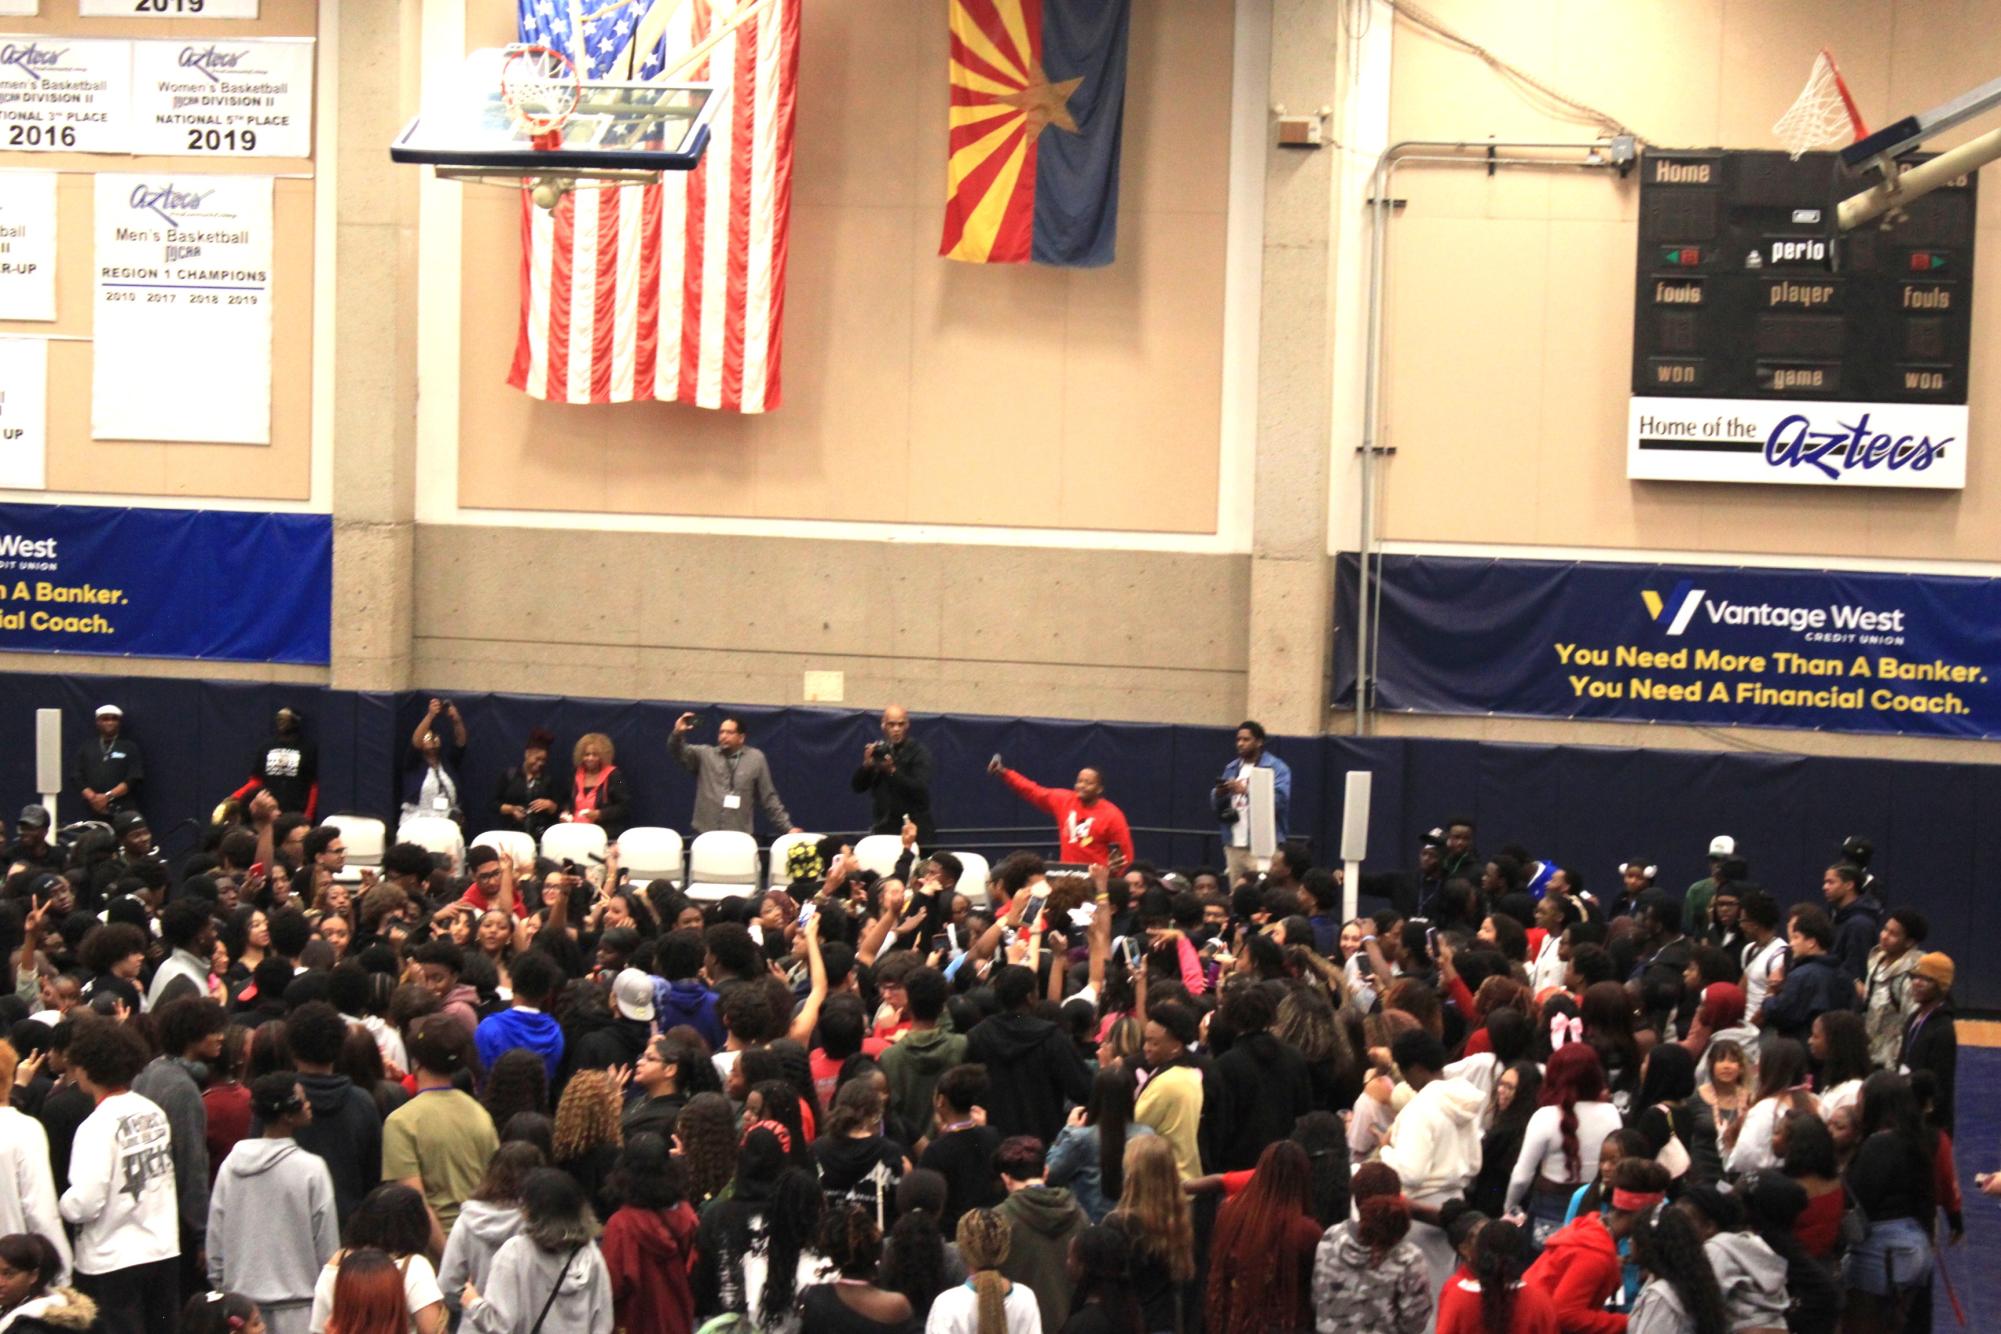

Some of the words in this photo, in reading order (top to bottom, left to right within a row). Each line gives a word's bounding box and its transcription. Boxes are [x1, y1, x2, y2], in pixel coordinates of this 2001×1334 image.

[135, 0, 205, 12] 2019
[42, 79, 107, 91] Basketball
[220, 82, 289, 94] Basketball
[22, 92, 81, 103] DIVISION
[201, 96, 262, 107] DIVISION
[66, 112, 108, 122] PLACE
[156, 114, 222, 125] NATIONAL
[247, 116, 289, 127] PLACE
[9, 125, 76, 146] 2016
[187, 129, 257, 151] 2019
[1655, 160, 1711, 184] Home
[116, 228, 161, 242] Men's
[167, 229, 249, 244] Basketball
[101, 267, 159, 280] REGION
[164, 269, 171, 280] 1
[176, 269, 267, 283] CHAMPIONS
[1656, 282, 1702, 304] fouls
[1770, 281, 1834, 307] player
[1904, 286, 1950, 309] fouls
[1657, 365, 1696, 383] won
[1773, 367, 1824, 390] game
[1904, 372, 1943, 390] won
[1639, 416, 1698, 436] Home
[1702, 417, 1722, 438] of
[1725, 417, 1757, 438] the
[11, 581, 32, 601] A
[35, 581, 129, 606] Banker.
[30, 611, 115, 634] Coach.
[1705, 600, 1827, 632] Vantage
[1830, 605, 1905, 632] West
[1804, 632, 1857, 644] CREDIT
[1858, 634, 1905, 646] UNION
[1554, 643, 1609, 667] You
[1615, 645, 1688, 669] Need
[1694, 649, 1767, 673] More
[1772, 652, 1844, 676] Than
[1849, 656, 1872, 678] A
[1877, 657, 1988, 684] Banker.
[1568, 675, 1624, 699] You
[1630, 677, 1703, 701] Need
[1707, 682, 1731, 703] A
[1736, 682, 1865, 710] Financial
[1870, 689, 1970, 714] Coach.
